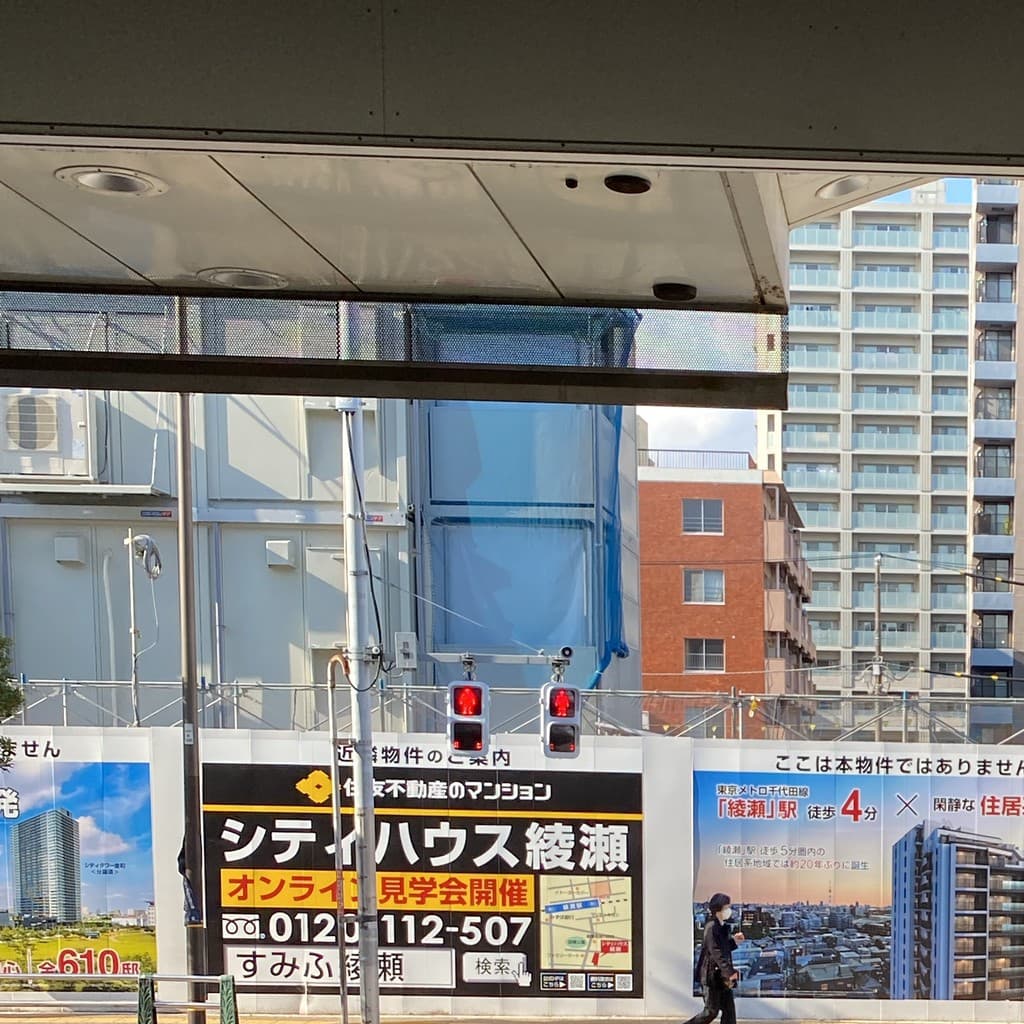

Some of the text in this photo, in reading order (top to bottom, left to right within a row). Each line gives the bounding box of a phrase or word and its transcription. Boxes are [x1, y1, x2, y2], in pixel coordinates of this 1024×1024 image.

[717, 785, 808, 797] 東京メトロ千代田線
[718, 800, 797, 819] 「綾瀬」駅
[221, 818, 630, 872] シティハウス綾瀬
[269, 912, 532, 946] 0120112-507
